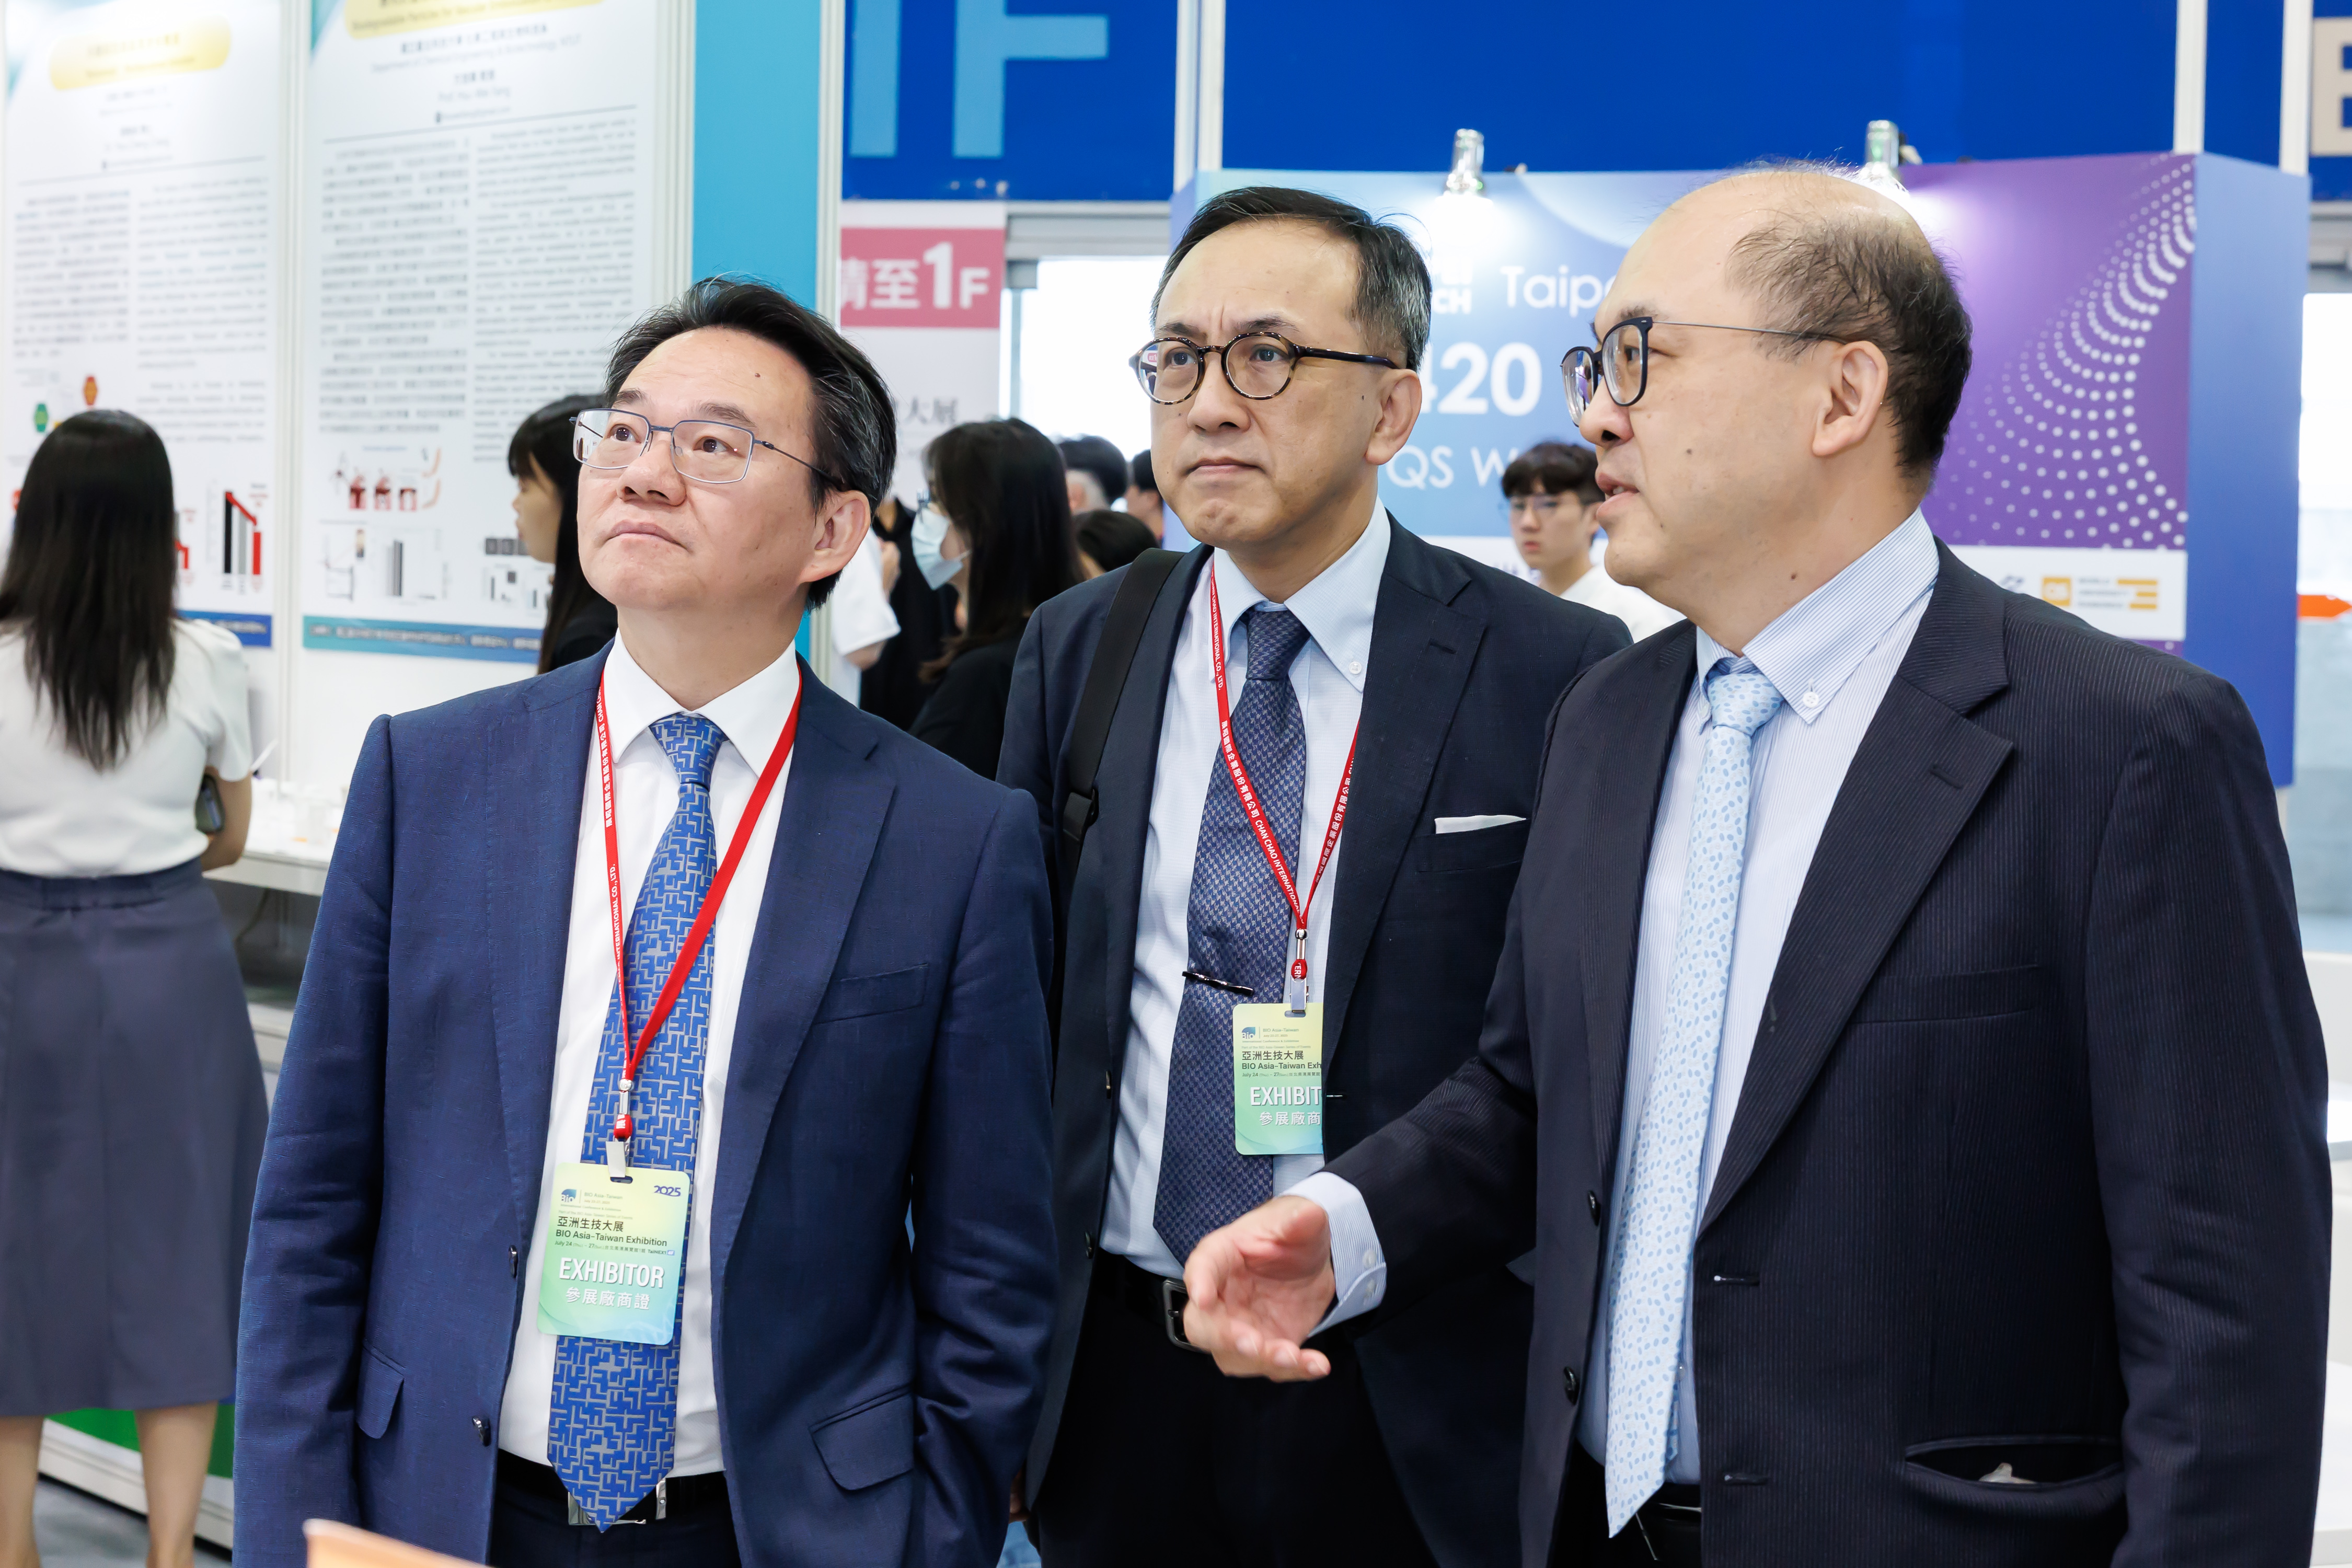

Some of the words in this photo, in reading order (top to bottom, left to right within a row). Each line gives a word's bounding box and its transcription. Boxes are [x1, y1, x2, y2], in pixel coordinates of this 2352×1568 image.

[1386, 445, 1455, 490] QS
[1255, 820, 1269, 839] CHAN
[1264, 839, 1278, 859] CHAO
[1273, 859, 1300, 913] INTERNATIONAL
[1242, 1050, 1304, 1060] 亞洲生技大展
[1250, 1086, 1322, 1106] EXHIBIT
[1259, 1111, 1321, 1126] 參展廠商
[557, 1216, 624, 1232] 亞洲生技大展
[556, 1229, 571, 1238] BIO
[573, 1231, 624, 1242] Asia-Taiwan
[626, 1236, 667, 1247] Exhibition
[559, 1257, 665, 1288] EXHIBITOR
[566, 1286, 650, 1310] 參展廠商證
